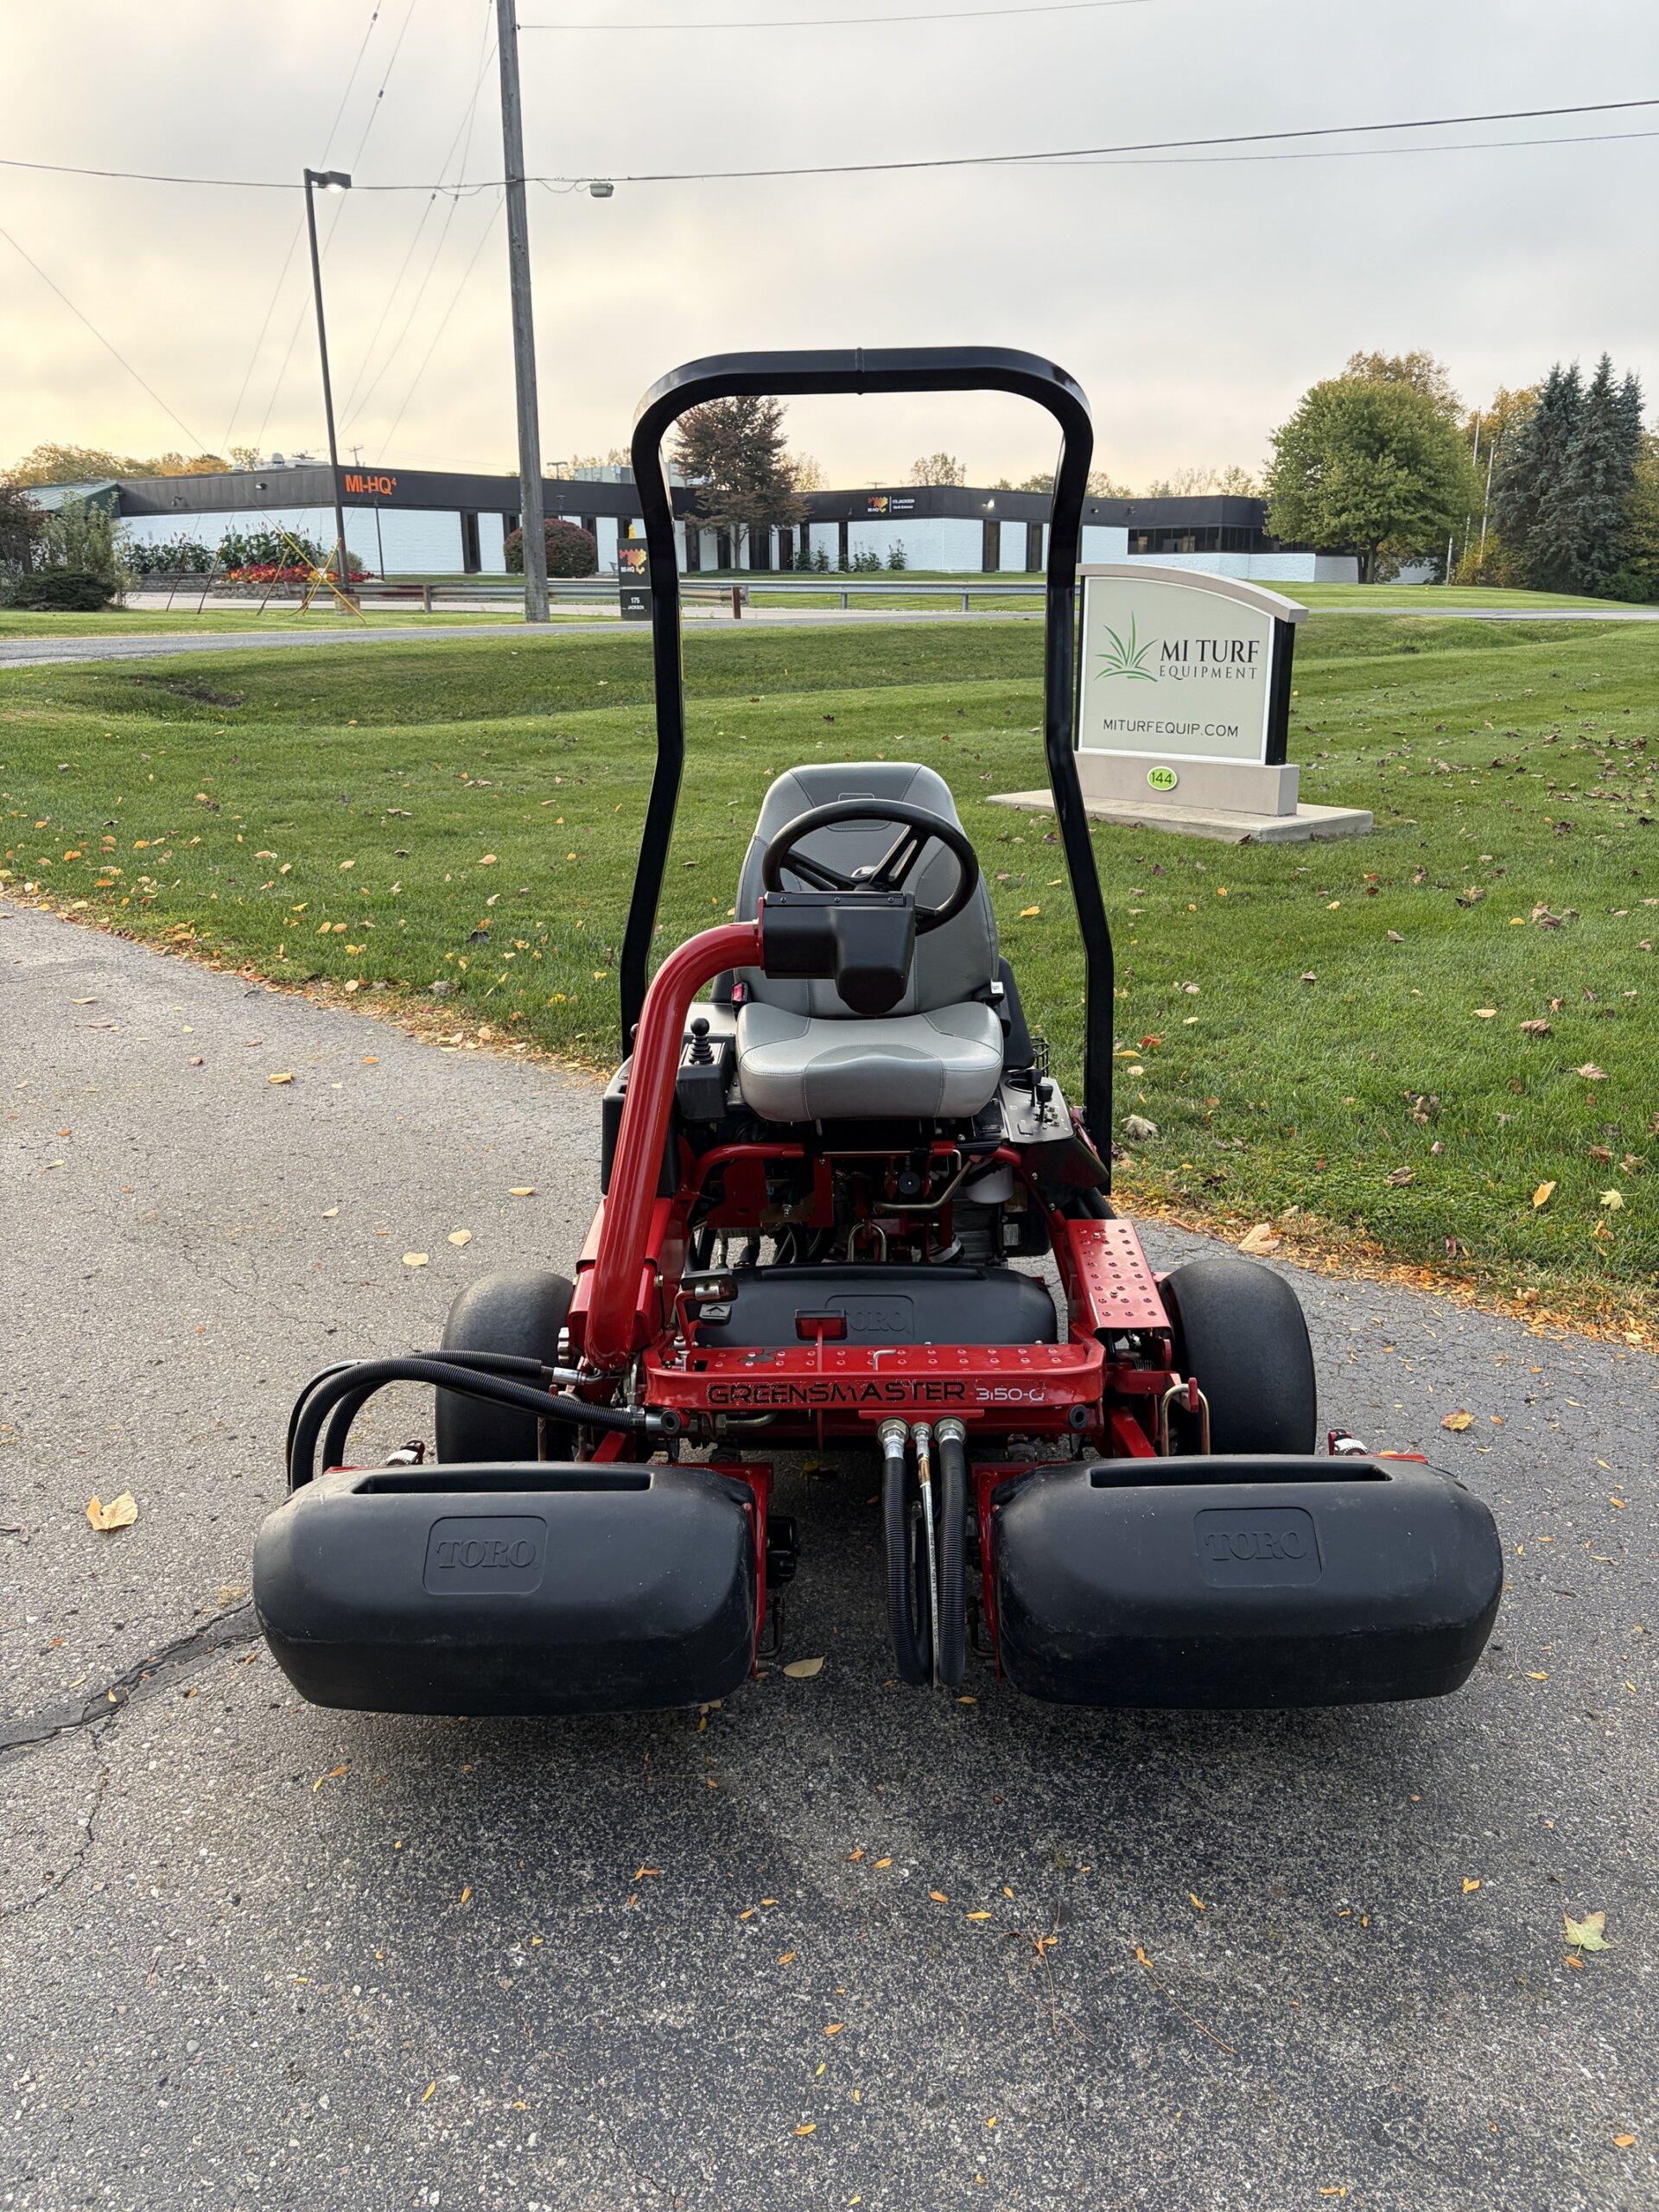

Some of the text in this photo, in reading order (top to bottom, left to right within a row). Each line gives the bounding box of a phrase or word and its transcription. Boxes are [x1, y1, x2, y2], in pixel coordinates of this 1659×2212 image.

[1160, 639, 1260, 664] MI TURF
[1159, 664, 1258, 681] EQUIPMENT
[1103, 718, 1238, 738] MITURFEQUIP.COM
[1151, 771, 1173, 785] 144
[846, 1311, 907, 1332] ORO
[707, 1382, 965, 1405] GREENSMASTER
[436, 1539, 537, 1569] TORO
[1205, 1532, 1307, 1561] TORO
